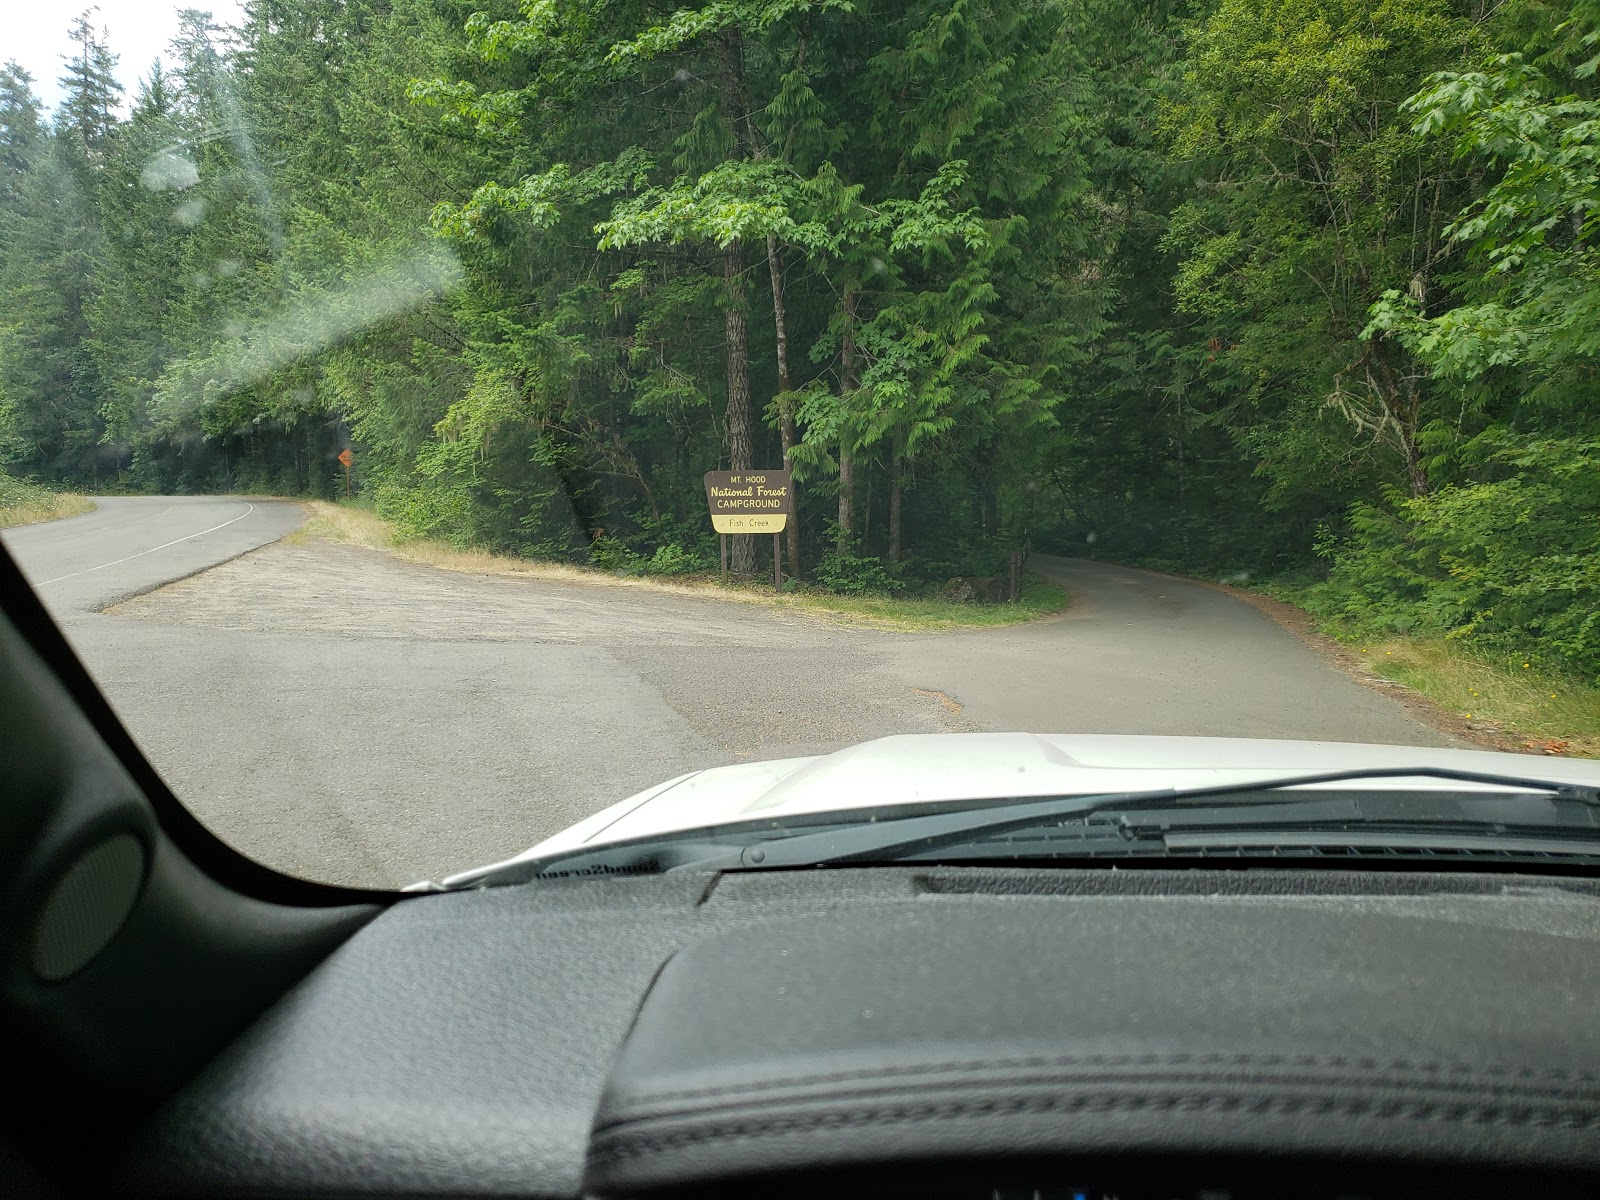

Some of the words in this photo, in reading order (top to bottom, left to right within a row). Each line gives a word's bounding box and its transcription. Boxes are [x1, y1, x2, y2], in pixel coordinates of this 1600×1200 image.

[745, 475, 766, 484] HOOD
[710, 486, 753, 497] National
[756, 486, 787, 497] Forest
[717, 499, 780, 508] CAMPGROUND
[729, 519, 744, 527] Fish
[749, 519, 769, 527] Creek
